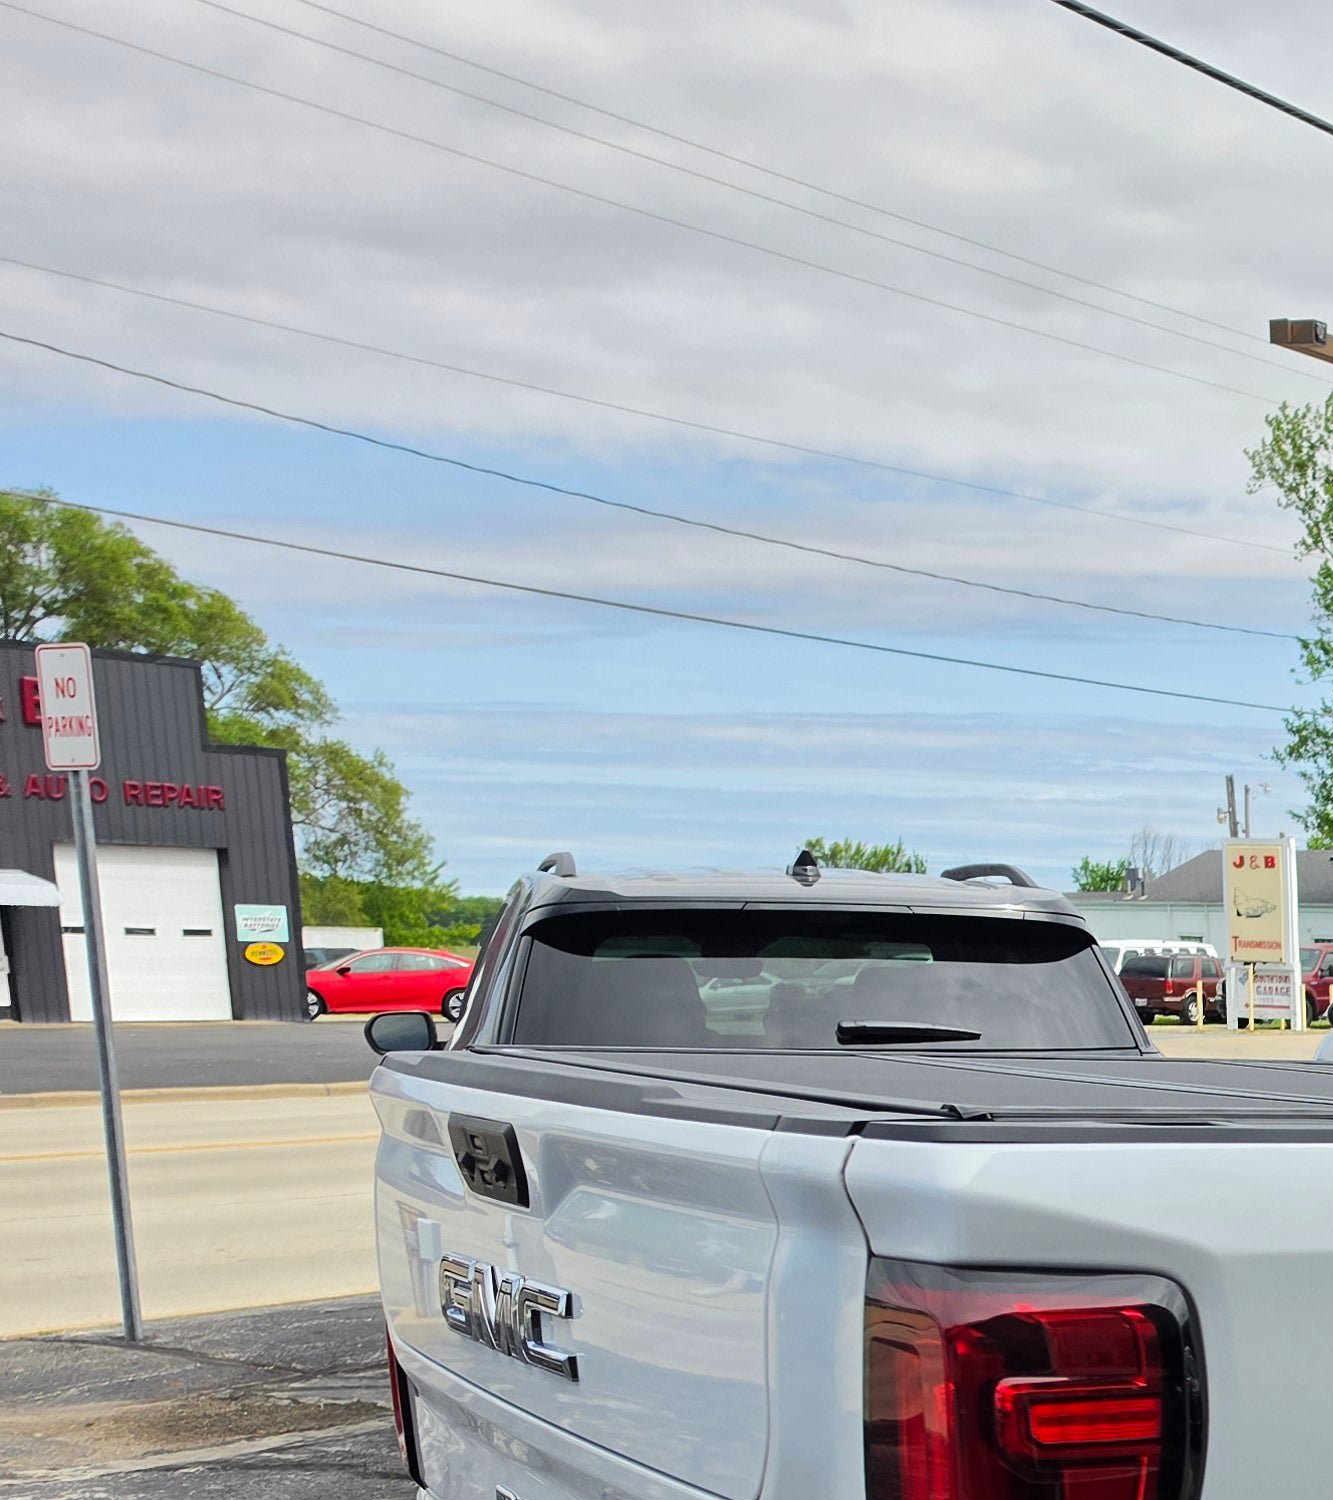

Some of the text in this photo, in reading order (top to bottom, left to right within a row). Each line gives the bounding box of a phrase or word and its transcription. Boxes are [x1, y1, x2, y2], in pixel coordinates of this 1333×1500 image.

[54, 677, 77, 699] NO
[47, 714, 93, 738] PARKING
[123, 779, 225, 811] REPAIR
[1232, 854, 1276, 870] J & B
[1255, 985, 1291, 997] GARAGE
[439, 1251, 580, 1383] GMC
